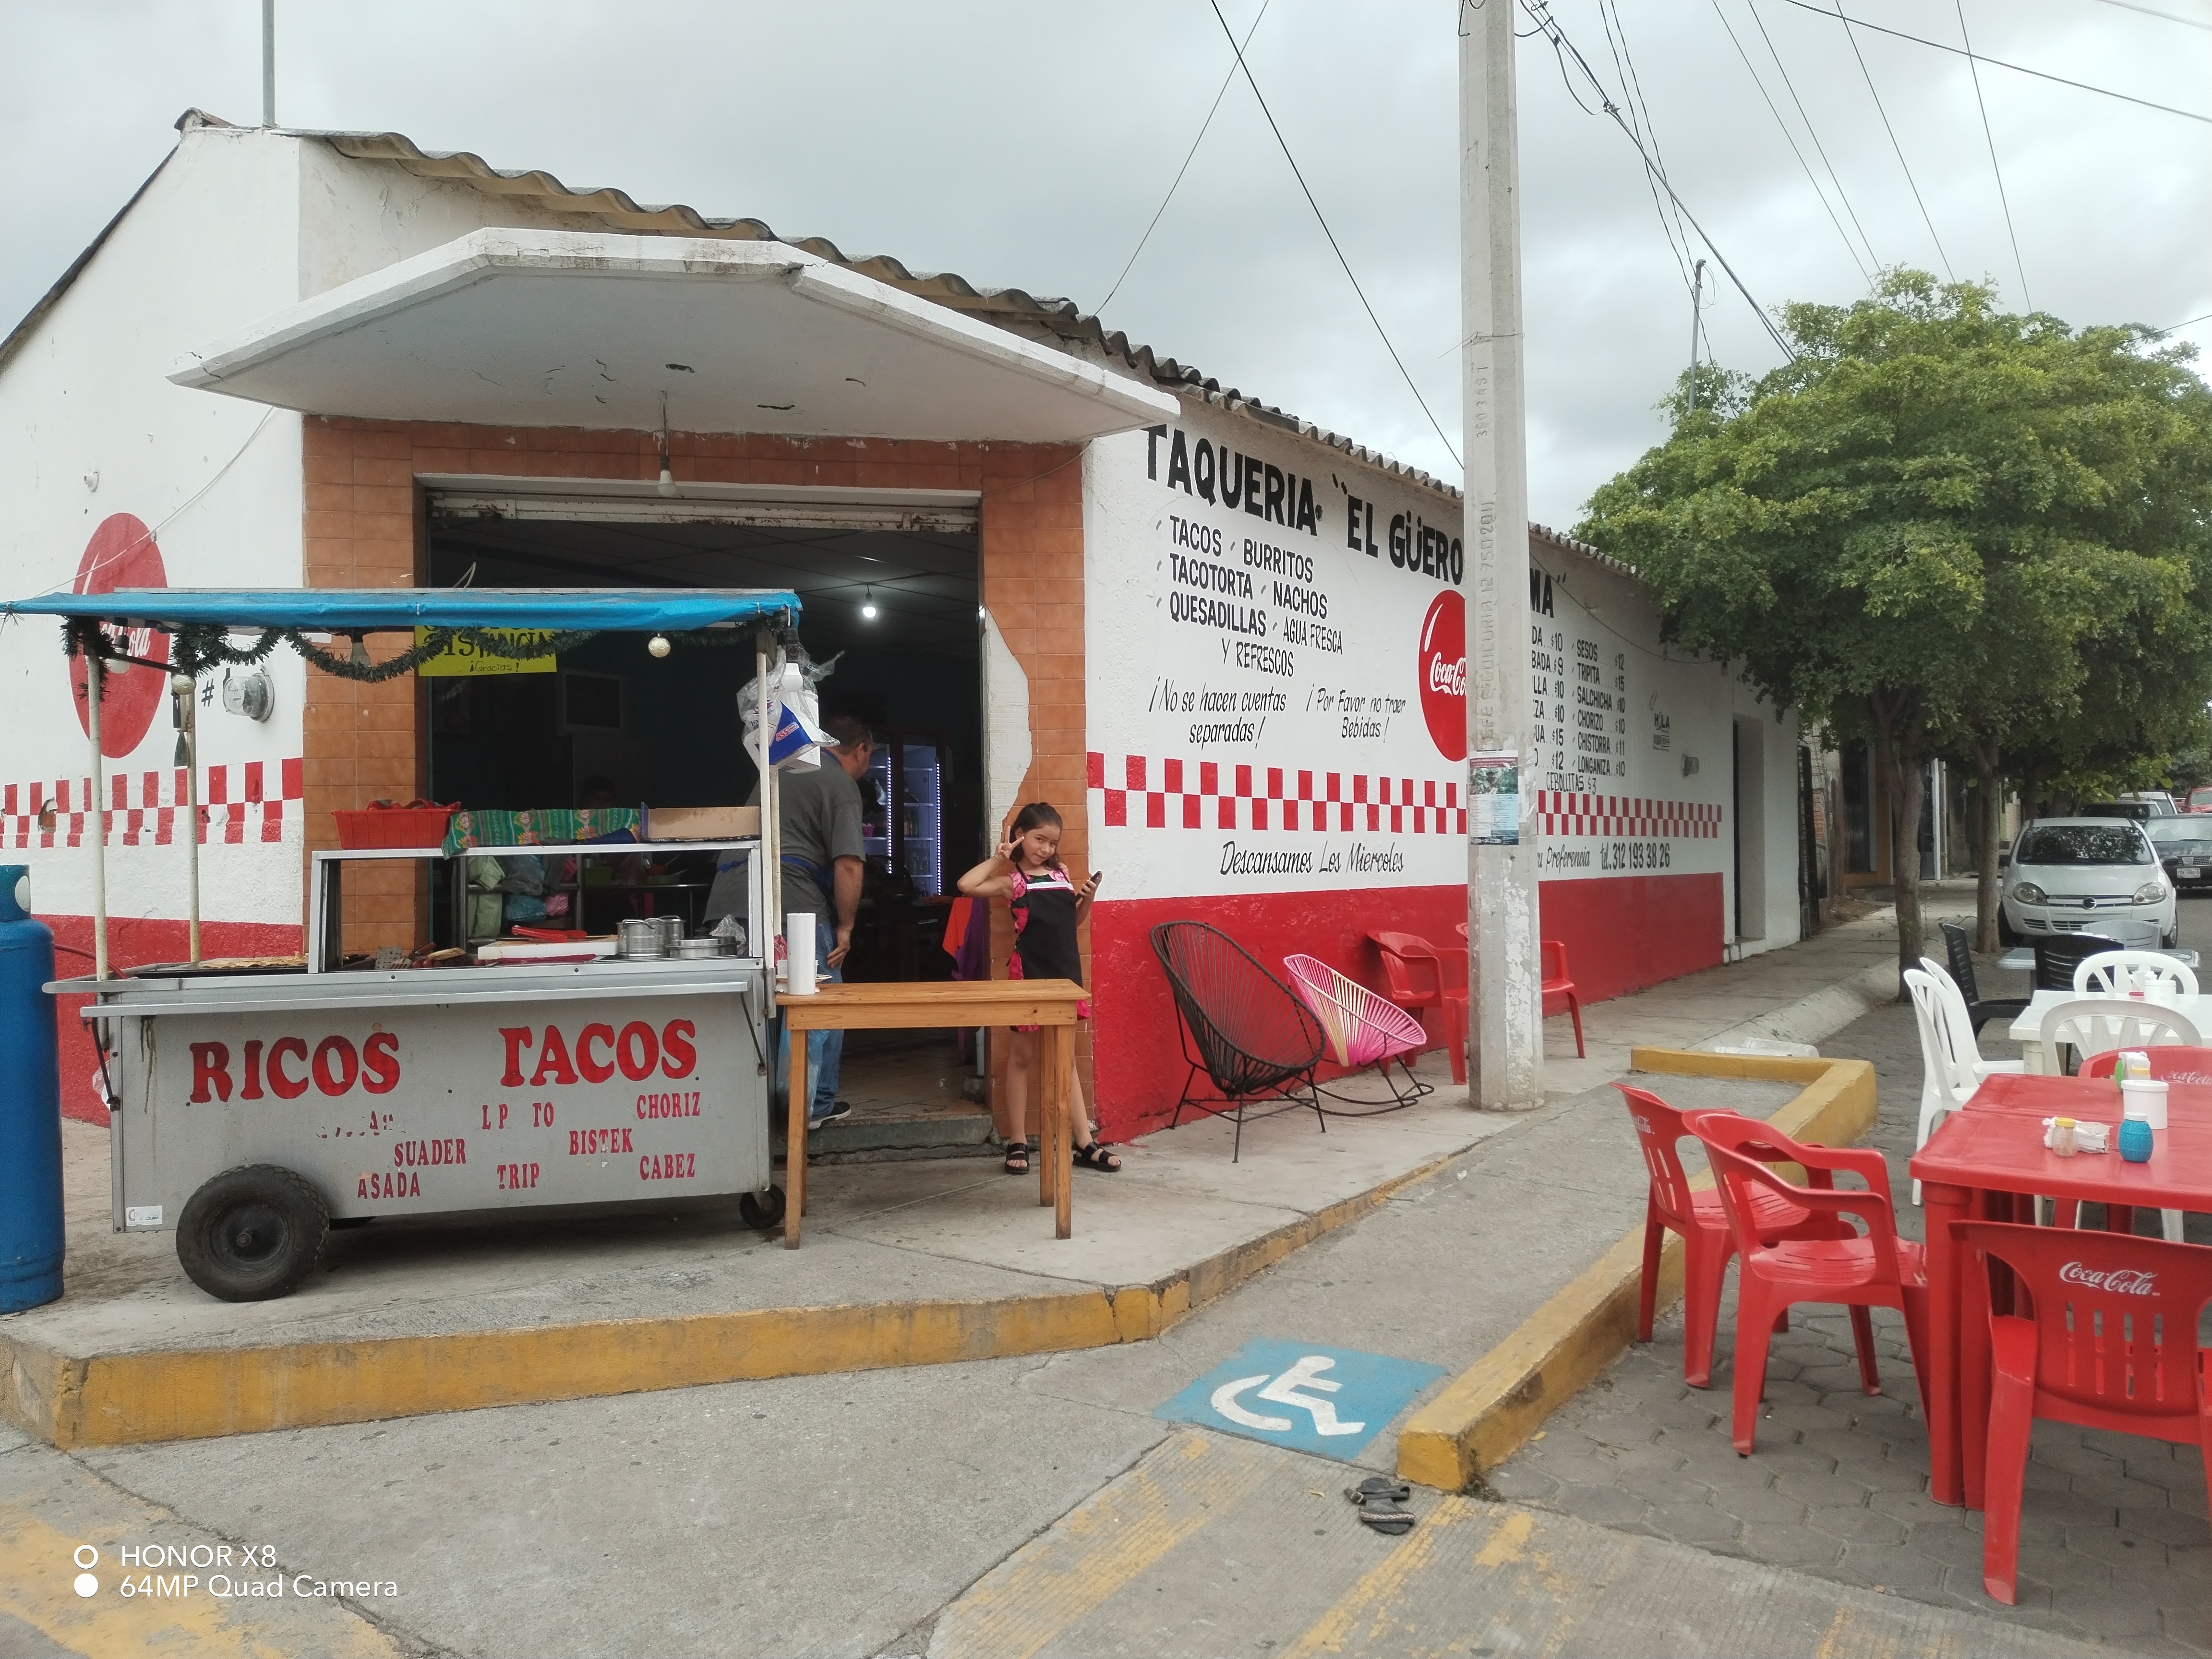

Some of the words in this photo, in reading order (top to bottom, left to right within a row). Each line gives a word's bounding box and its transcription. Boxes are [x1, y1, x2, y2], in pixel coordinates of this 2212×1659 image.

[1140, 423, 1317, 536] TAQUERIA
[1389, 510, 1464, 586] GÜERO
[1170, 515, 1222, 556] TACOS
[1243, 538, 1313, 583] BURRITOS
[1169, 553, 1253, 600] TACOTORTA
[1273, 584, 1327, 619] NACHOS
[1169, 592, 1267, 637] QUESADILLAS
[1283, 617, 1307, 647] AGUA
[1310, 624, 1343, 655] FRESCA
[1532, 625, 1542, 647] DA
[1222, 637, 1230, 664] Y
[1236, 641, 1294, 677] REFRESCOS
[1532, 649, 1551, 673] BADA
[1577, 639, 1598, 662] SESOS
[1533, 674, 1547, 696] LLA
[1577, 662, 1600, 685] TRIPITA
[1181, 690, 1194, 712] se
[1199, 682, 1237, 713] hacen
[1241, 686, 1286, 712] cuentas
[1337, 689, 1365, 713] Favor
[1370, 697, 1382, 712] no
[1384, 695, 1406, 714] traer
[1577, 685, 1612, 711] SALCHICHA
[1577, 709, 1603, 732] CHORIZO
[1577, 731, 1611, 755] CHISTORRA
[1577, 755, 1611, 776] LONGANIZA
[1546, 771, 1584, 793] CEBOLLITAS
[1220, 841, 1313, 876] Descansamos
[1319, 841, 1342, 874] Los
[1345, 842, 1405, 875] Miercoles
[1545, 844, 1591, 874] Preferencia
[1629, 842, 1644, 869] 193
[1647, 842, 1657, 869] 38
[1659, 842, 1670, 868] 26
[189, 1032, 401, 1103] RICOS
[498, 1019, 697, 1087] TACOS
[637, 1092, 700, 1120] CHORIZ
[394, 1138, 467, 1167] SUADER
[569, 1128, 633, 1155] BISTEK
[497, 1163, 540, 1190] TRIP
[639, 1153, 695, 1181] CABEZ
[357, 1172, 421, 1200] ASADA
[2059, 1261, 2158, 1295] Coca-Cola
